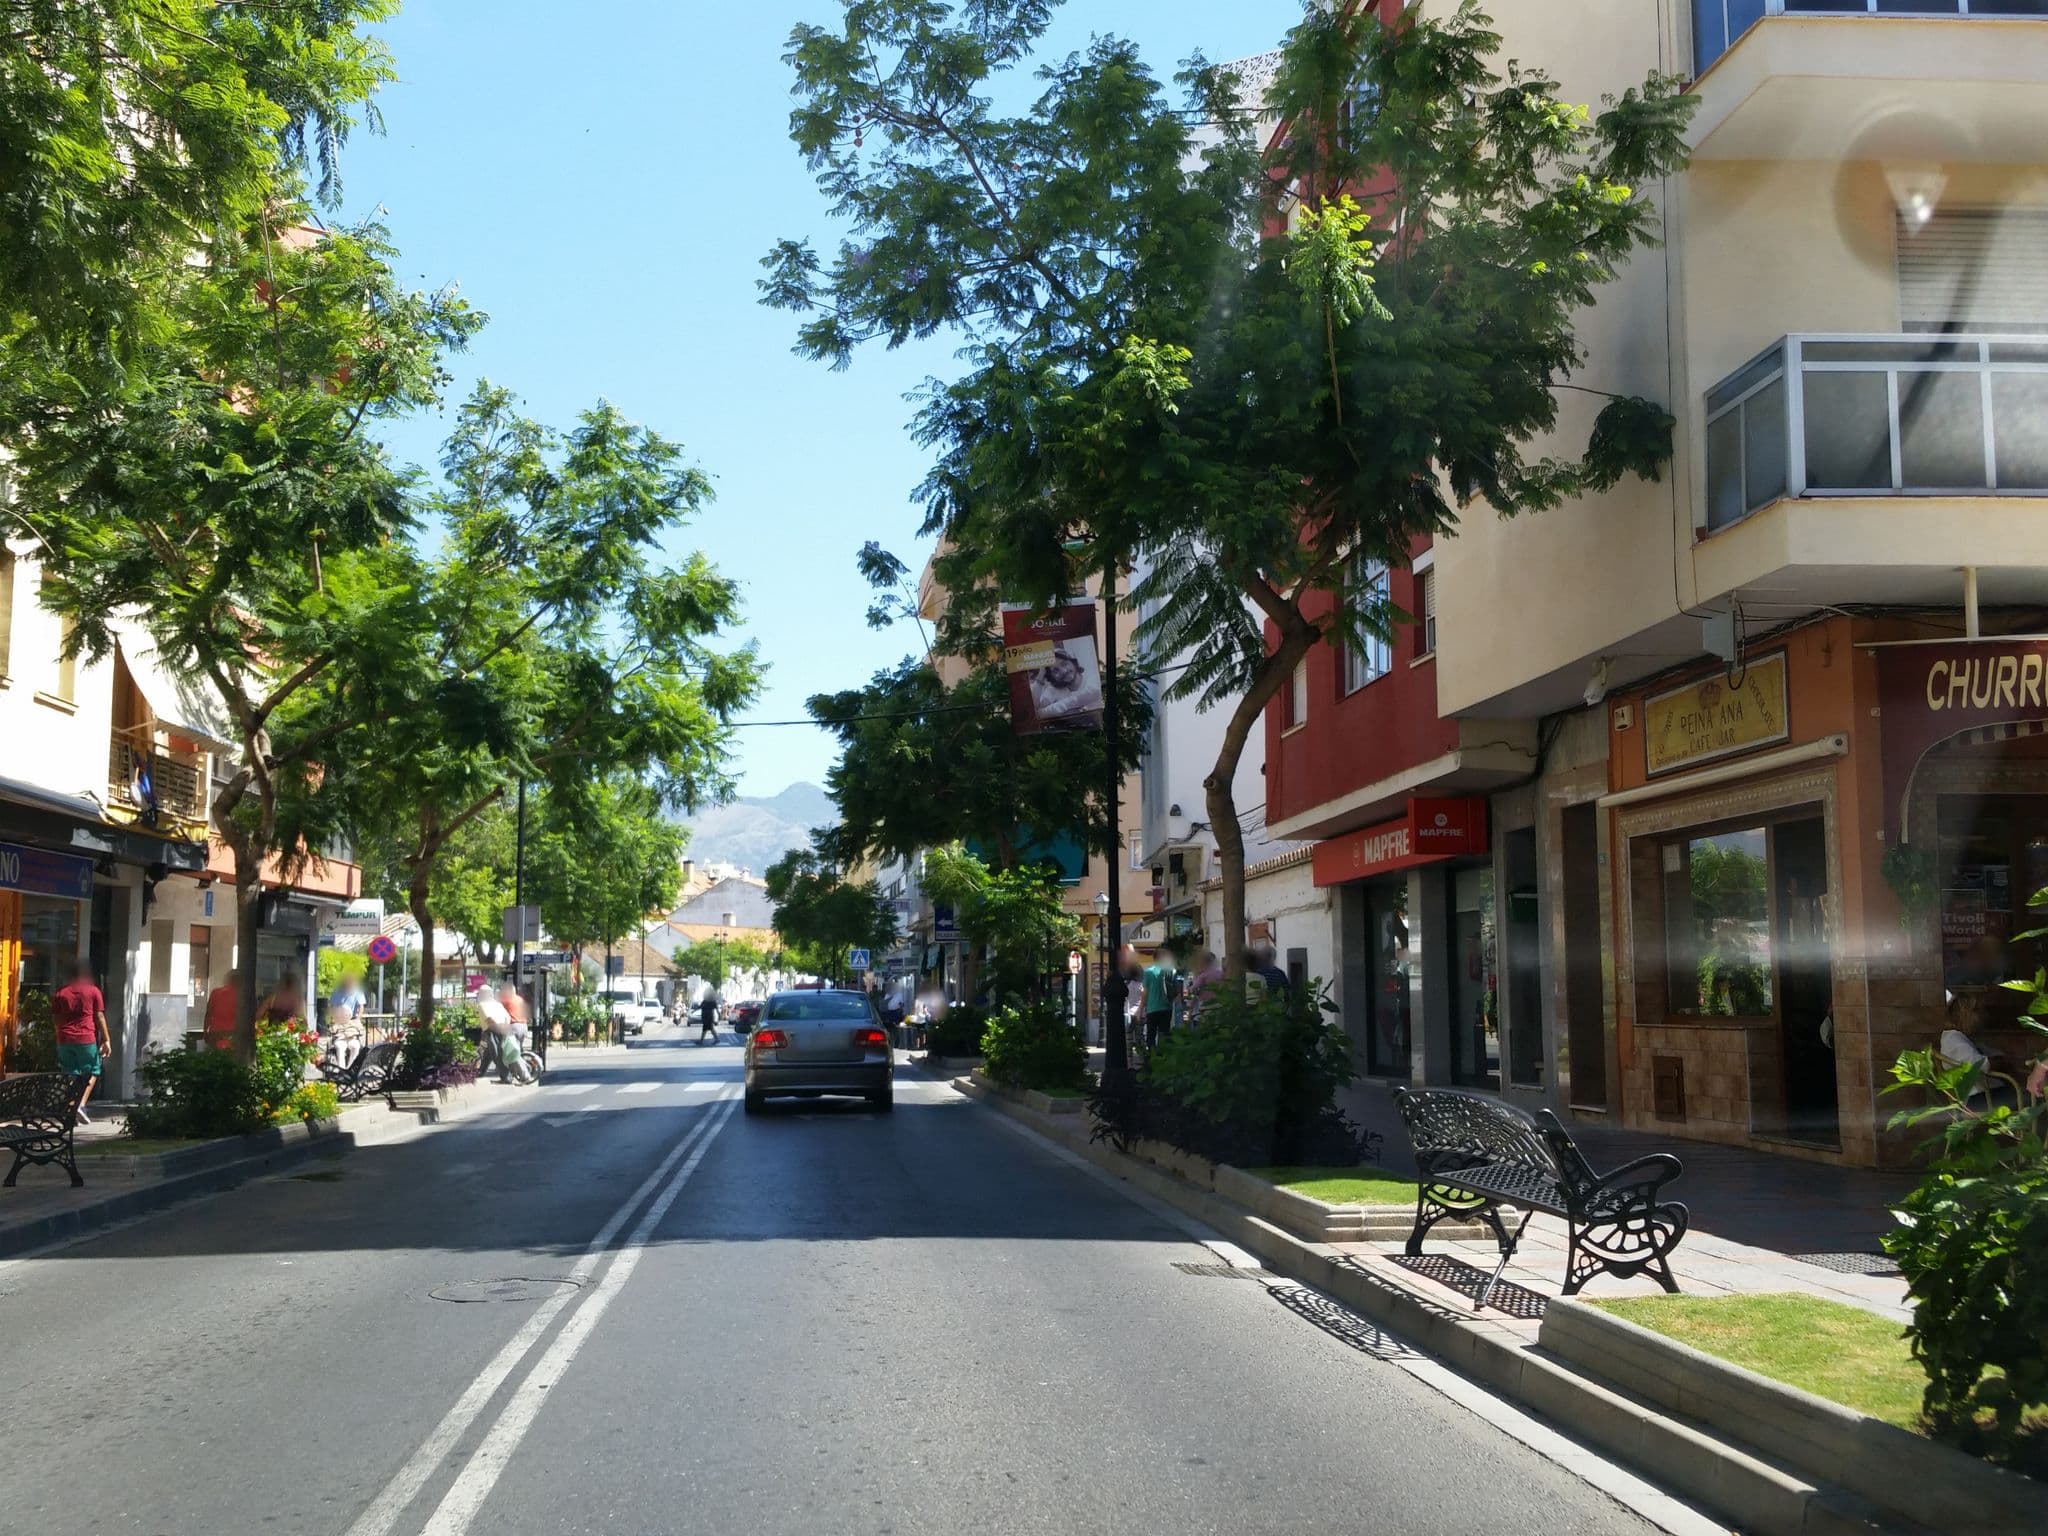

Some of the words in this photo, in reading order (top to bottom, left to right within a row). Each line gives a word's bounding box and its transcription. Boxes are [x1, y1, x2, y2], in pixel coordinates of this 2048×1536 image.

[1006, 648, 1018, 659] 19
[1927, 654, 2048, 711] CHURR
[1720, 700, 1745, 725] ANA
[1419, 828, 1465, 837] MAPFRE
[1363, 828, 1410, 865] MAPFRE
[335, 911, 377, 919] TEMPUR
[1942, 912, 1985, 923] Tivoli
[1942, 924, 1985, 935] World
